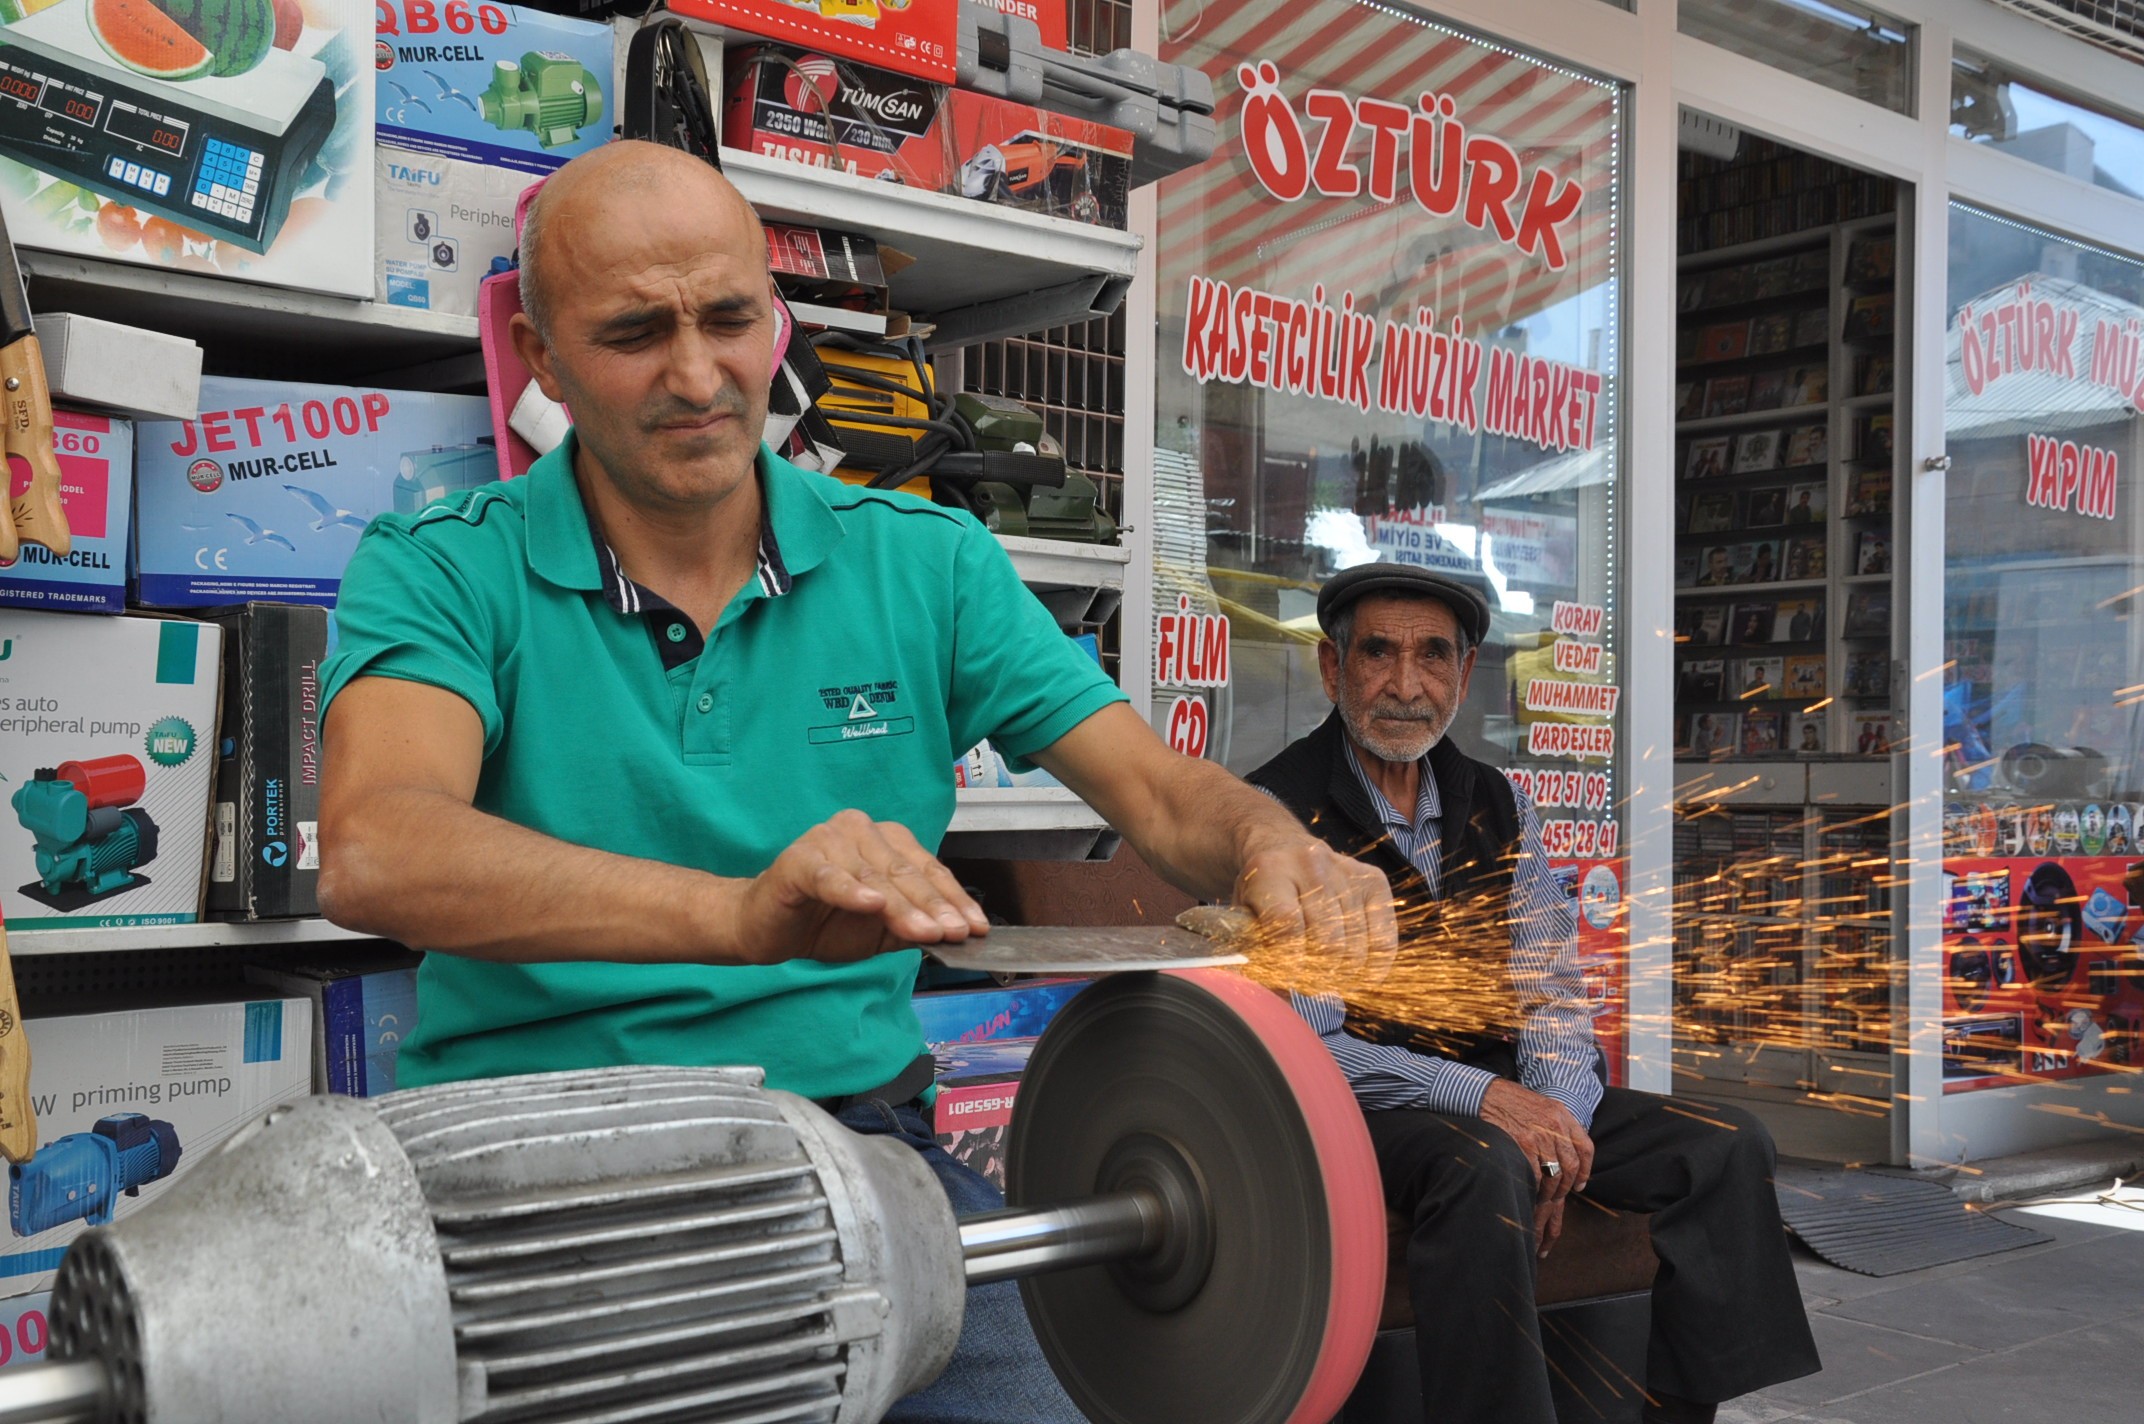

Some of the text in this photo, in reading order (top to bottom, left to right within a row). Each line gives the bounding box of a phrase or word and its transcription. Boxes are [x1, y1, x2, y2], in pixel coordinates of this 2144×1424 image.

[399, 45, 484, 62] MUR-CELL
[765, 111, 802, 134] 2350
[851, 127, 870, 146] 230
[1238, 61, 1583, 270] ÖZTÜRK
[1959, 281, 2079, 396] ÖZTÜRK
[1378, 307, 1483, 434] MÜZİK
[1484, 347, 1602, 452] MARKET
[170, 393, 390, 457] JET100P
[228, 449, 337, 481] MUR-CELL
[2027, 433, 2118, 519] YAPIM
[48, 592, 106, 603] TRADEMARKS
[1551, 601, 1603, 636] KORAY
[1156, 593, 1230, 687] FİLM
[1554, 640, 1603, 675] VEDAT
[16, 696, 58, 712] auto
[1526, 679, 1620, 716] MUHAMMET
[90, 721, 141, 739] pump
[301, 659, 317, 785] IMPACT DRILL
[1166, 696, 1208, 759] CD
[153, 739, 188, 754] NEW
[1528, 722, 1614, 762] KARDEŞLER
[266, 779, 278, 836] PORTEK
[1535, 770, 1563, 807] 212
[1564, 772, 1585, 808] 51
[1585, 773, 1607, 810] 99
[1574, 820, 1597, 857] 28
[1598, 820, 1618, 857] 41
[72, 1082, 161, 1113] priming
[168, 1077, 231, 1102] pump
